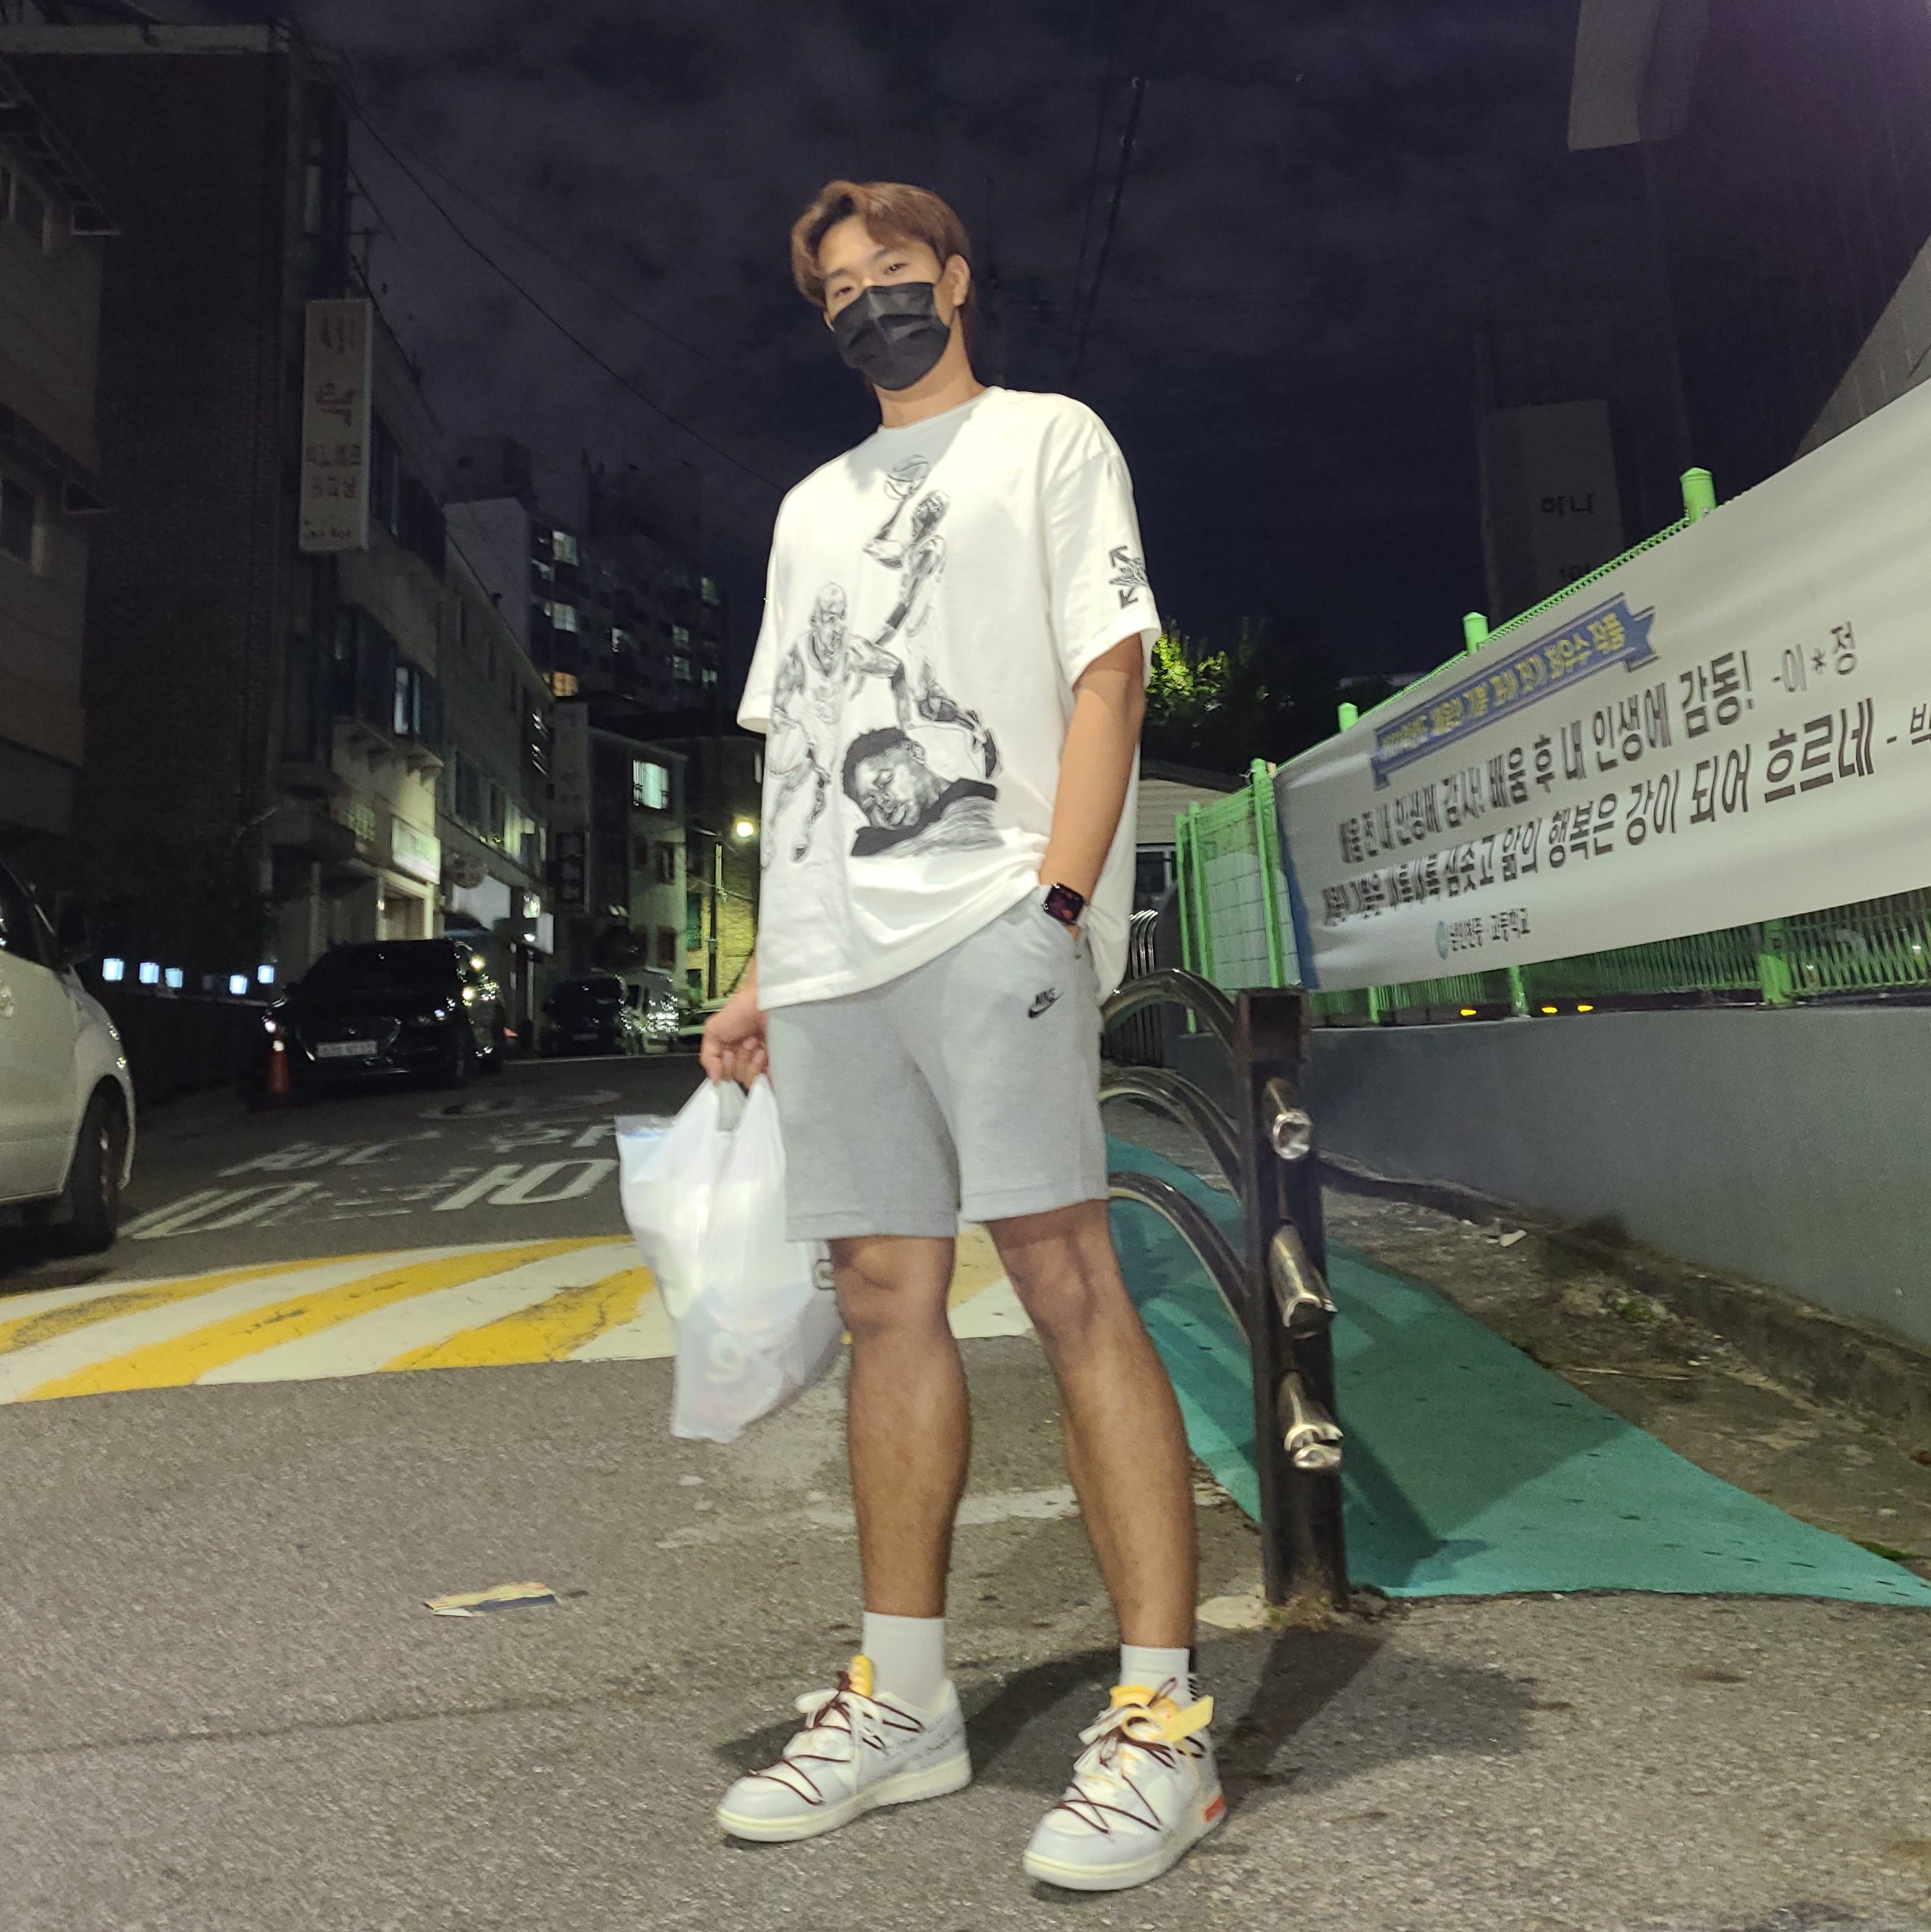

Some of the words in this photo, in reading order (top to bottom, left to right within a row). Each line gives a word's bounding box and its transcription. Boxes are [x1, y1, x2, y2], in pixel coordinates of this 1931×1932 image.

[1395, 783, 1442, 846] 인생에
[1487, 746, 1529, 809] 배움
[1532, 734, 1556, 794] 후
[1560, 720, 1589, 780] 내
[1593, 682, 1672, 773] 인생에
[1679, 650, 1755, 739] 감동!
[1444, 833, 1496, 898] 샘솟고
[1547, 791, 1619, 870] 행복은
[1625, 768, 1682, 846] 강이
[1689, 743, 1752, 824] 되어
[1764, 697, 1875, 804] 흐르네
